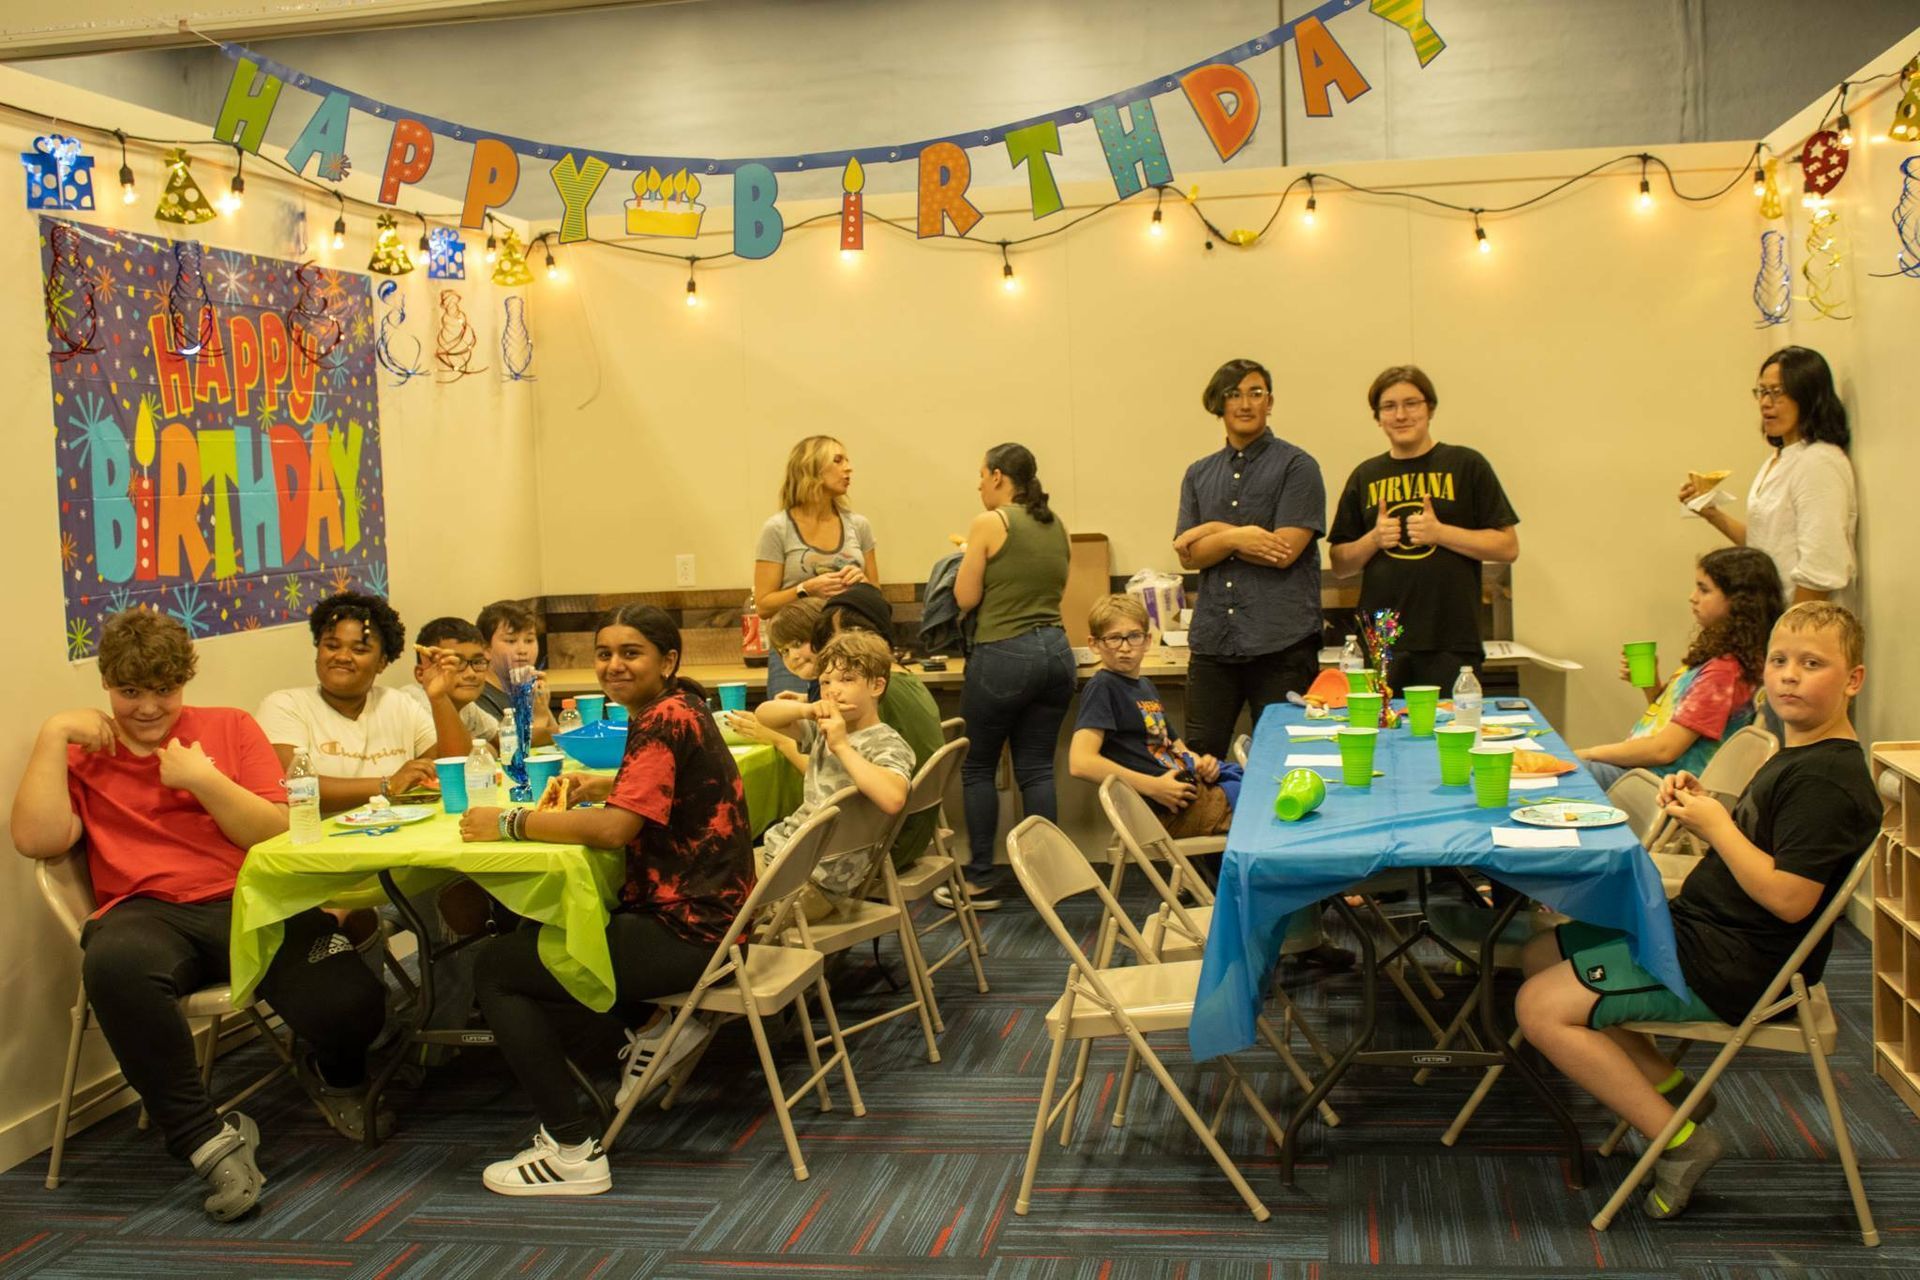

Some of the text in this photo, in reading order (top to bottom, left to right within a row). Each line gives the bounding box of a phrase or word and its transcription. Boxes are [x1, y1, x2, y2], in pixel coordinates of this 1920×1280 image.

[213, 0, 1446, 260] HAPPY BIRTHDAY
[149, 304, 318, 425] HAPPY
[90, 400, 364, 584] BIRTHDAY
[1366, 472, 1456, 509] NIRVANA
[320, 741, 406, 765] Champion
